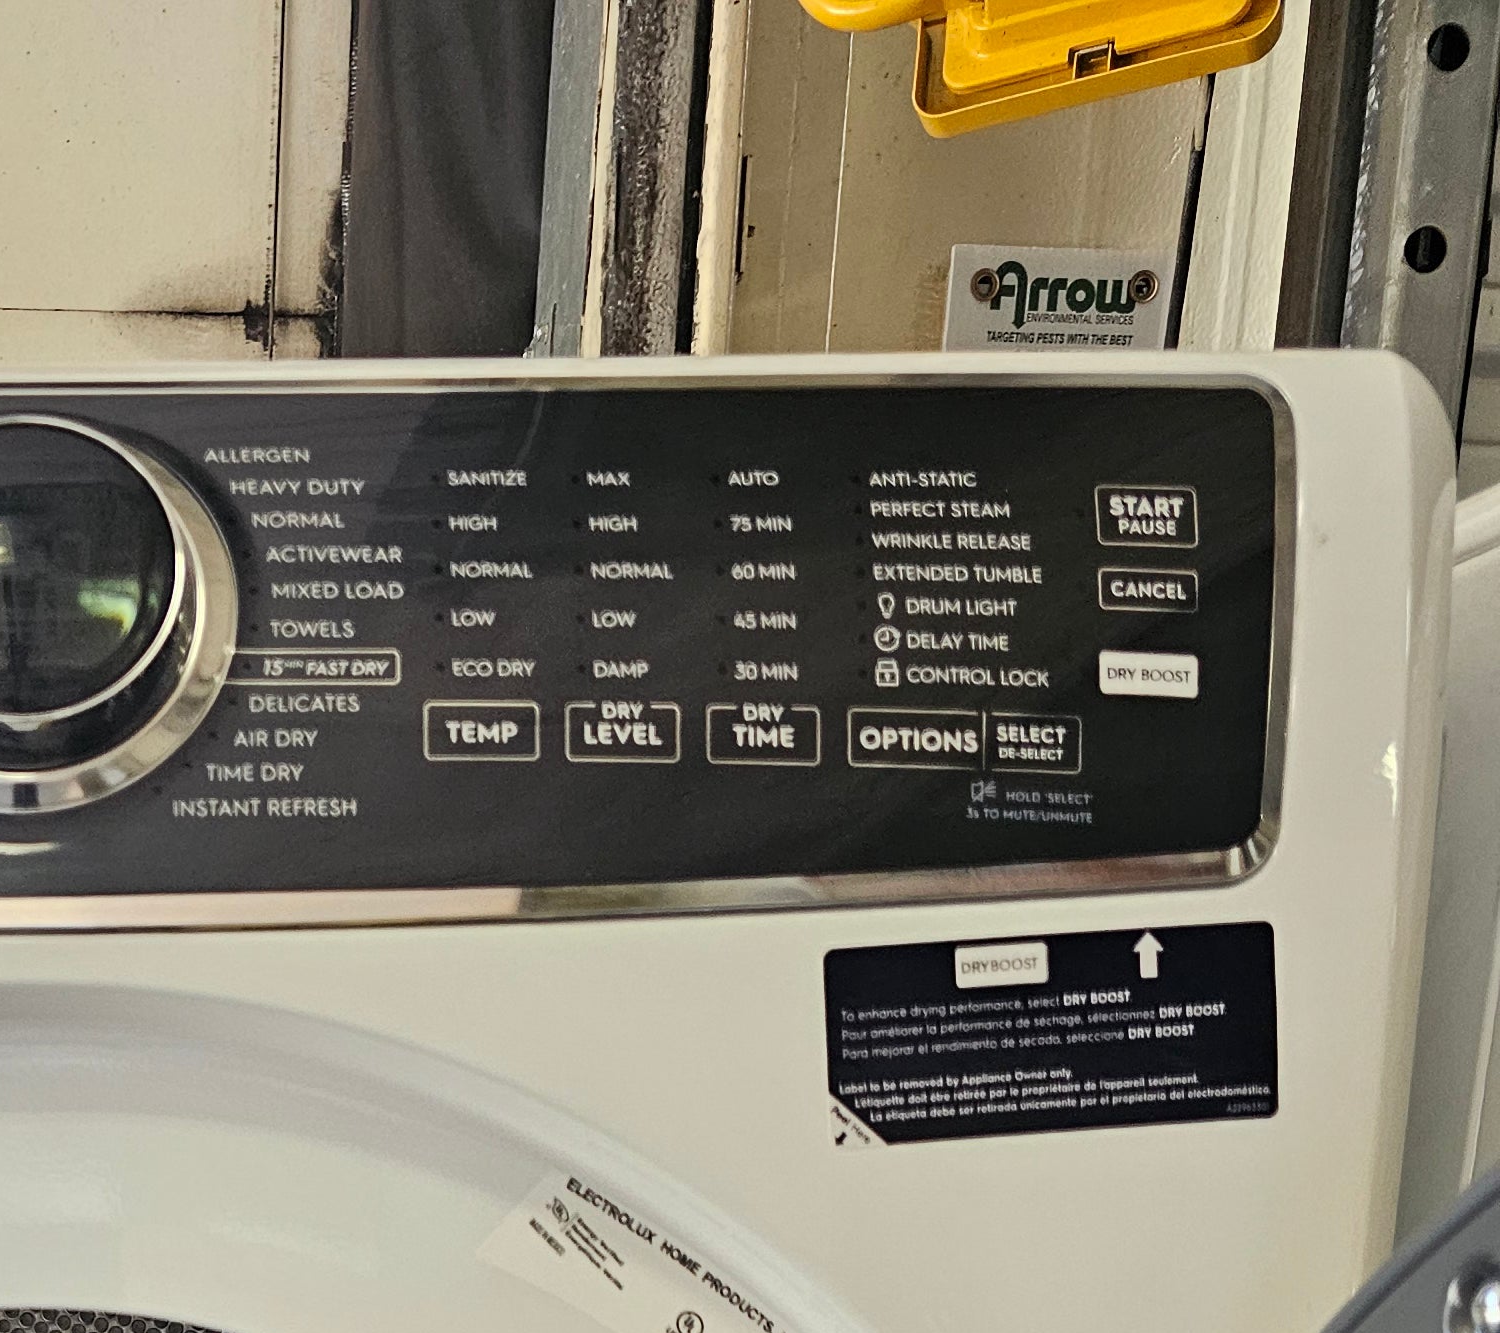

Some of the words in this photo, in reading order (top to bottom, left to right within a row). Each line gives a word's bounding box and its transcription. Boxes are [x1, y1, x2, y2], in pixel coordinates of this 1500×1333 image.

[989, 260, 1137, 330] Arrow
[1026, 312, 1093, 324] ENVIRONMENTAL
[1095, 313, 1134, 325] SERVICES
[987, 330, 1035, 344] TARGETING
[1038, 332, 1064, 345] PESTS
[1066, 333, 1089, 345] WITH
[1090, 334, 1108, 346] THE
[1109, 335, 1133, 346] BEST
[204, 448, 311, 464] ALLERGEN
[229, 479, 301, 496] HEAVY
[307, 479, 366, 496] DUTY
[446, 471, 527, 487] SANITIZE
[586, 471, 631, 487] MAX
[728, 471, 779, 487] AUTO
[869, 472, 977, 488] ANTI-STATIC
[870, 502, 946, 519] PERFECT
[950, 502, 1010, 519] STEAM
[1109, 496, 1184, 519] START
[251, 511, 346, 529] NORMAL
[448, 516, 497, 533] HIGH
[588, 516, 638, 534] HIGH
[730, 516, 754, 533] 75
[756, 516, 792, 533] MIN
[1118, 519, 1177, 537] PAUSE
[871, 533, 953, 551] WRINKLE
[957, 534, 1031, 551] RELEASE
[266, 546, 403, 564] ACTIVEWEAR
[450, 562, 534, 580] NORMAL
[590, 562, 673, 581] NORMAL
[731, 563, 755, 581] 60
[758, 563, 796, 581] MIN
[873, 566, 969, 583] EXTENDED
[973, 566, 1042, 585] TUMBLE
[271, 582, 340, 600] MIXED
[344, 581, 405, 601] LOAD
[1111, 580, 1187, 601] CANCEL
[905, 598, 961, 617] DRUM
[966, 599, 1017, 617] LIGHT
[451, 610, 496, 628] LOW
[591, 610, 636, 628] LOW
[733, 612, 756, 630] 45
[759, 612, 797, 631] MIN
[270, 619, 356, 639] TOWELS
[906, 633, 963, 651] DELAY
[968, 634, 1010, 652] TIME
[305, 660, 349, 677] FAST
[351, 660, 390, 677] DRY
[451, 660, 493, 678] ECO
[496, 660, 536, 678] DRY
[593, 660, 649, 679] DAMP
[733, 662, 758, 681] 30
[760, 663, 798, 682] MIN
[906, 668, 995, 687] CONTROL
[1000, 670, 1050, 688] LOCK
[1107, 666, 1135, 681] DRY
[1141, 668, 1190, 683] BOOST
[249, 694, 361, 713] DELICATES
[601, 702, 644, 722] DRY
[742, 703, 784, 723] DRY
[233, 729, 269, 747] AIR
[274, 729, 319, 748] DRY
[446, 720, 519, 745] TEMP
[583, 724, 662, 747] LEVEL
[732, 725, 795, 749] TIME
[859, 727, 979, 754] OPTIONS
[996, 725, 1067, 745] SELECT
[998, 747, 1064, 762] DE-SELECT
[205, 764, 254, 782] TIME
[260, 763, 304, 782] DRY
[1006, 791, 1041, 803] HOLD
[172, 798, 261, 818] INSTANT
[267, 799, 358, 818] REFRESH
[983, 807, 1000, 820] TO
[961, 959, 990, 974] DRY
[990, 956, 1038, 973] BOOST
[841, 1009, 855, 1022] To
[858, 1006, 907, 1022] enhance
[909, 1003, 947, 1018] drying
[1027, 994, 1060, 1009] select
[1063, 992, 1087, 1007] DRY
[841, 1028, 867, 1041] Pour
[926, 1023, 938, 1035] la
[940, 1019, 1013, 1035] performance
[1015, 1016, 1031, 1028] de
[1159, 1005, 1183, 1019] DRY
[842, 1047, 869, 1061] Para
[871, 1044, 915, 1059] mejorar
[917, 1043, 929, 1054] el
[1000, 1037, 1015, 1049] de
[1128, 1025, 1152, 1041] DRY
[839, 1081, 867, 1096] Label
[870, 1081, 881, 1093] to
[883, 1079, 897, 1092] be
[899, 1074, 944, 1090] removed
[946, 1075, 959, 1088] by
[961, 1071, 1012, 1086] Appliance
[1014, 1069, 1048, 1082] Owner
[907, 1091, 928, 1104] doit
[989, 1087, 1007, 1100] par
[1009, 1085, 1019, 1097] le
[1083, 1080, 1097, 1092] de
[870, 1109, 883, 1123] La
[959, 1103, 974, 1116] ser
[977, 1101, 1018, 1114] retirada
[1080, 1093, 1098, 1107] por
[1099, 1091, 1110, 1105] el
[1169, 1087, 1185, 1100] del
[566, 1177, 656, 1245] ELECTROLUX
[660, 1239, 702, 1277] HOME
